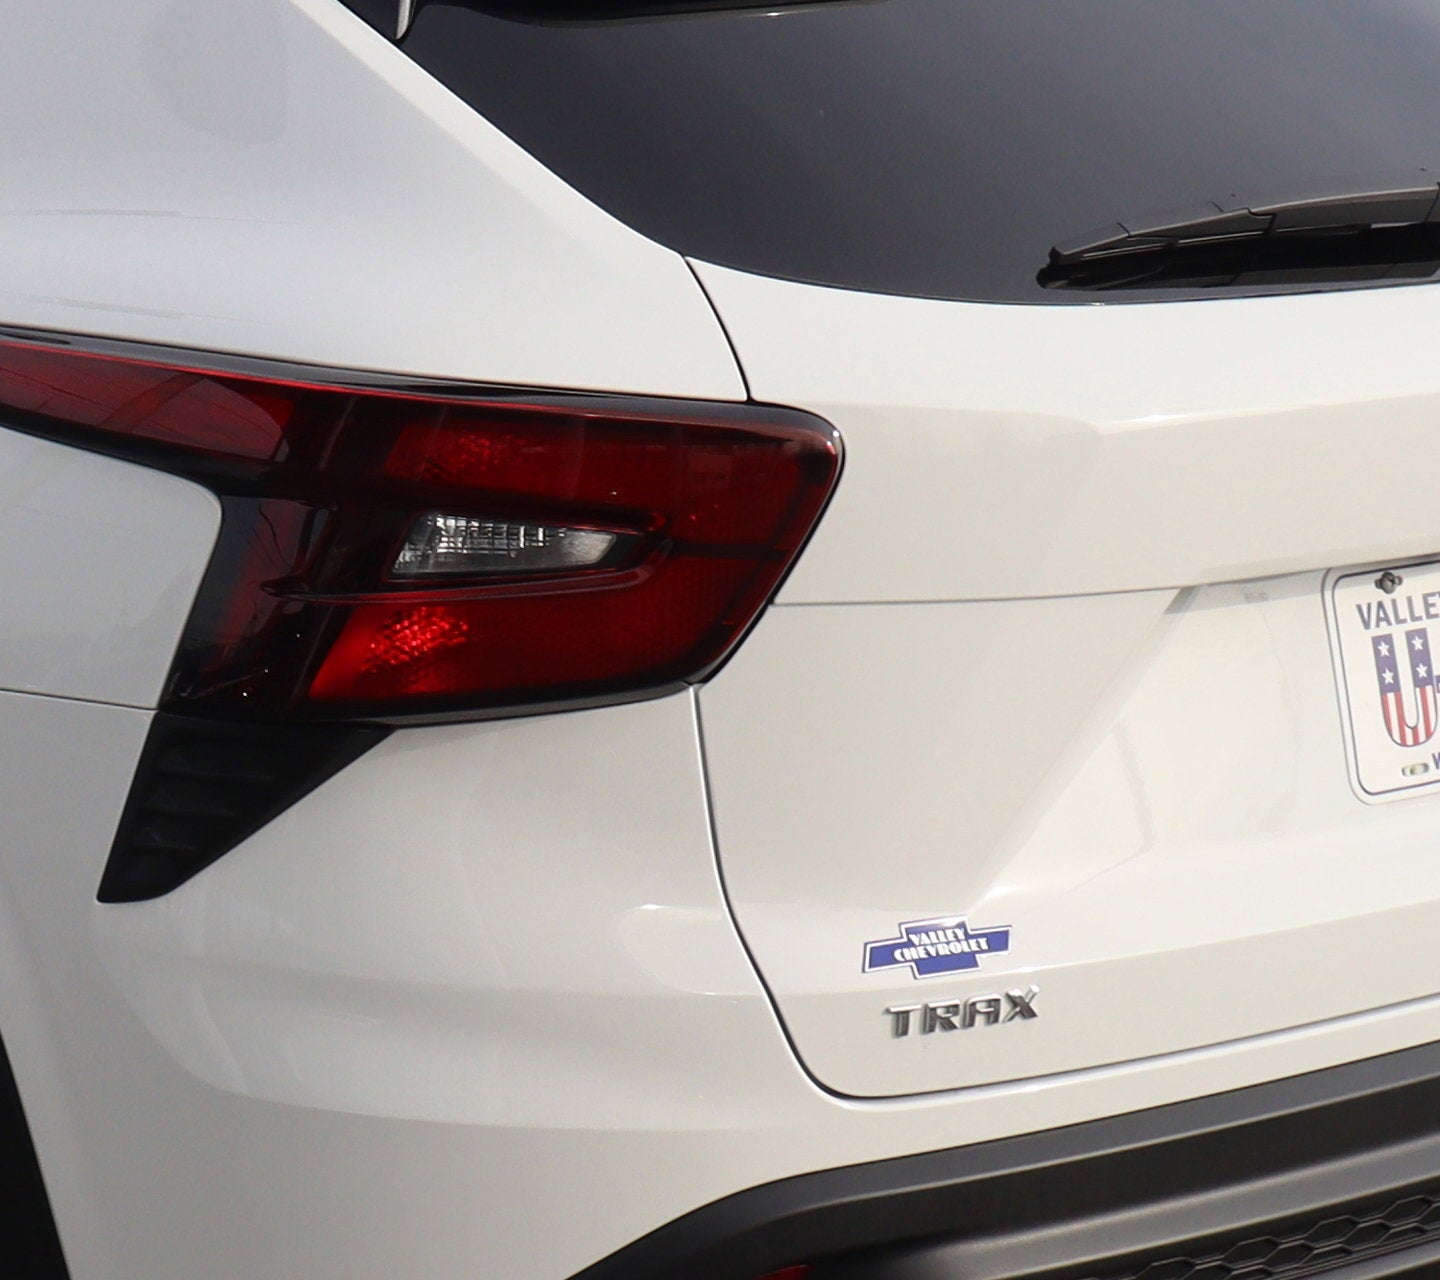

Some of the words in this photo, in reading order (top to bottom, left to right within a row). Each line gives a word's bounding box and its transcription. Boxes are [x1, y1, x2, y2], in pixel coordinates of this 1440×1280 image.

[893, 937, 989, 963] CHEVROLET
[908, 928, 967, 947] VALLEY
[885, 985, 1040, 1038] TRAX
